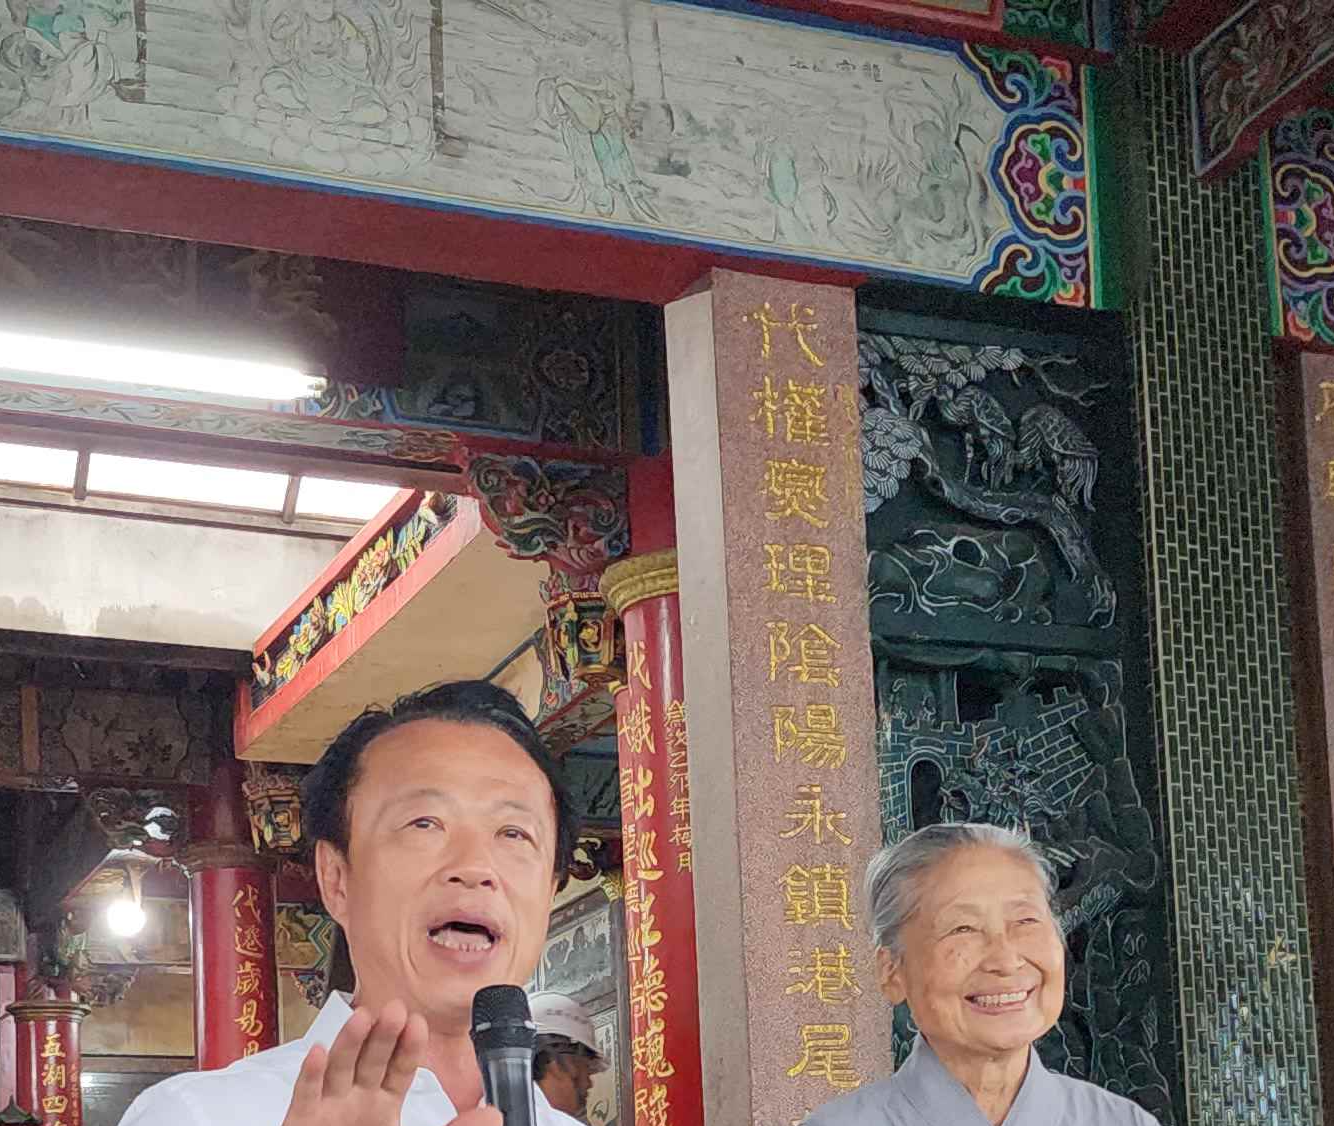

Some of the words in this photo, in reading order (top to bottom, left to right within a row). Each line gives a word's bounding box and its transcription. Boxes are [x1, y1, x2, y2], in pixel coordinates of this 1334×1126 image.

[742, 302, 863, 1126] 代權燮理陰陽永鎮港尾
